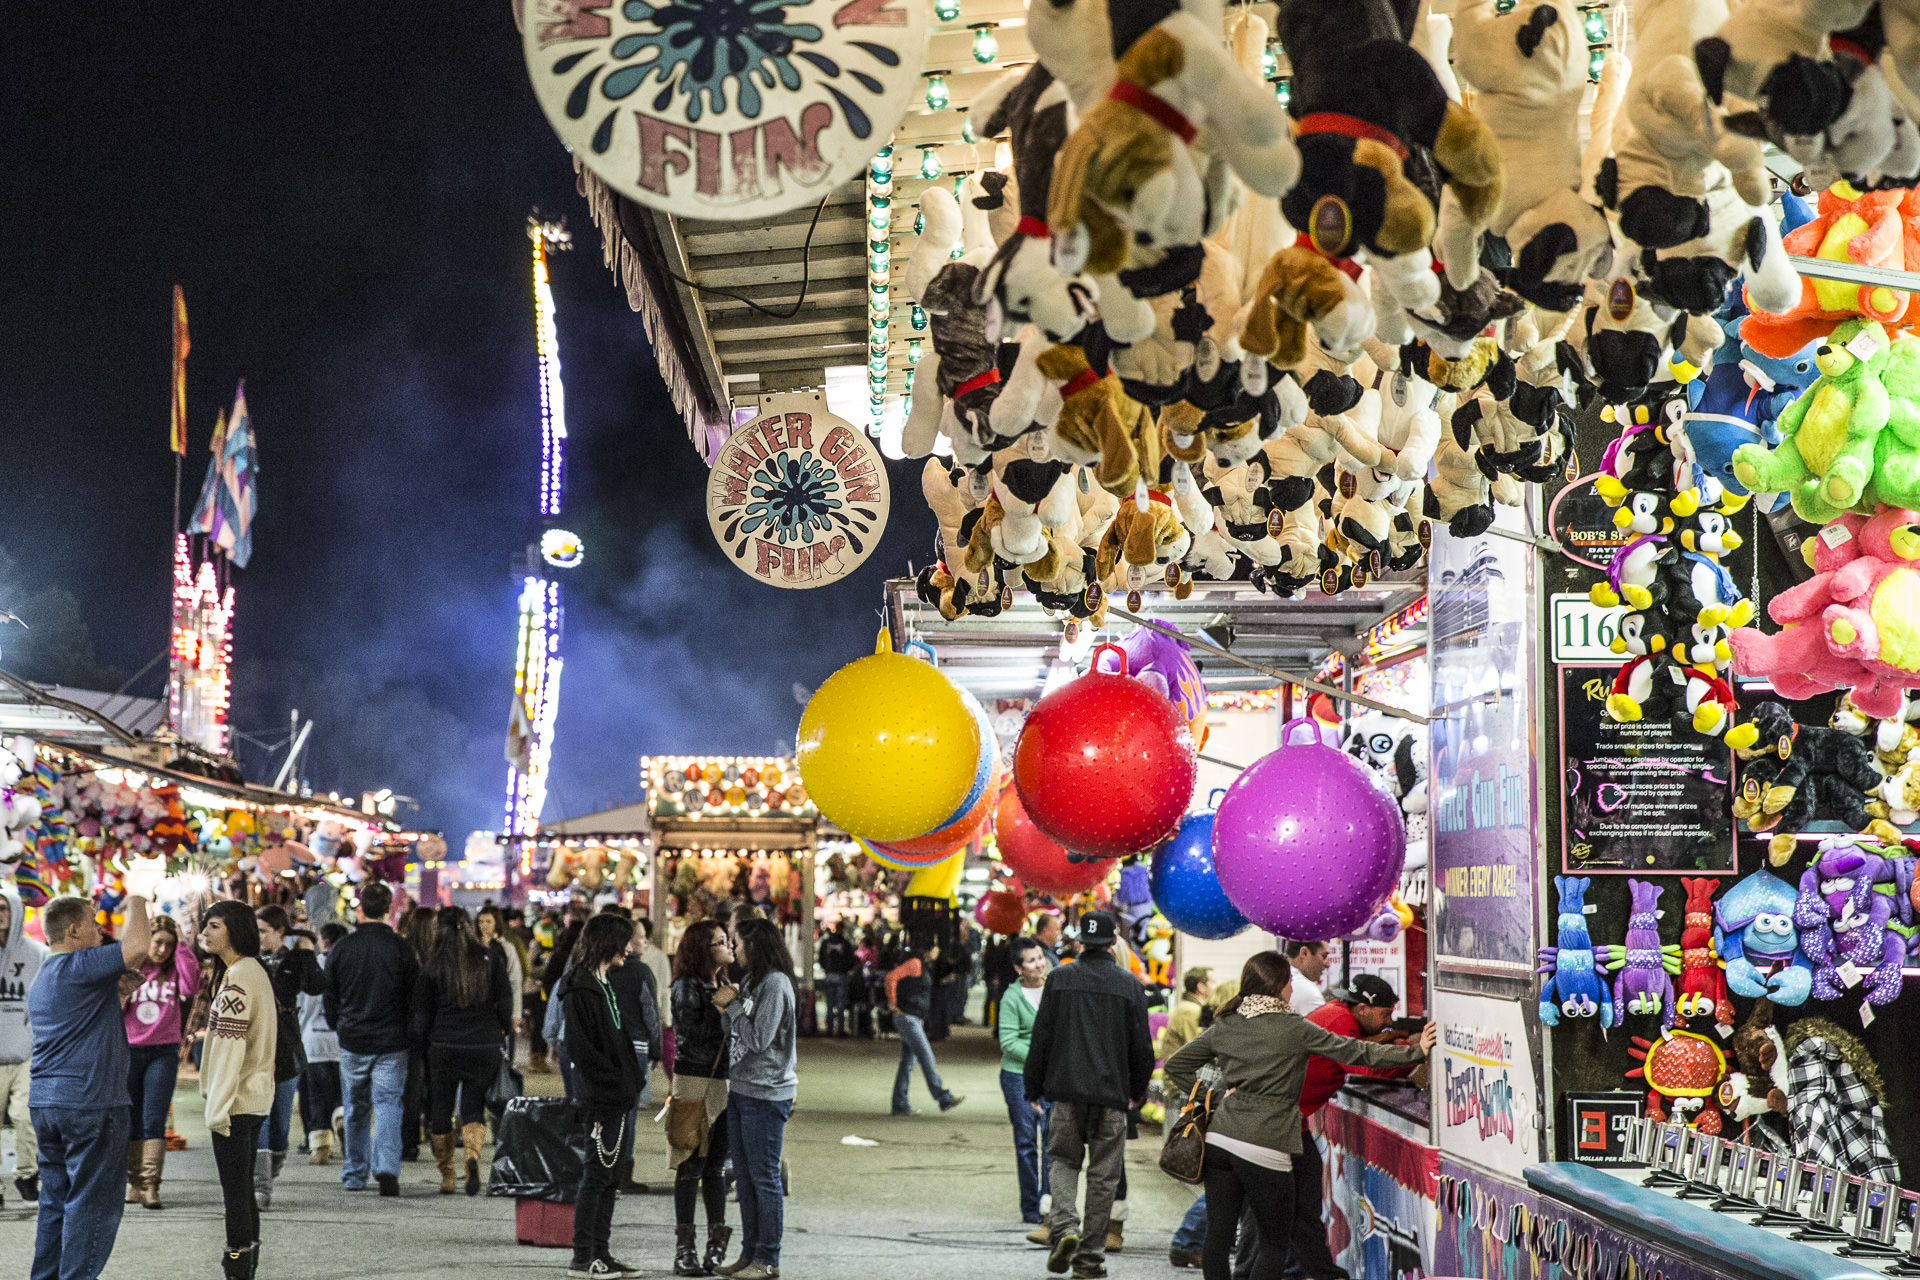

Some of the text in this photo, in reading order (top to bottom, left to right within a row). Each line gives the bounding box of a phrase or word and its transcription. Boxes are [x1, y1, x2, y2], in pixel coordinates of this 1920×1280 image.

[634, 101, 833, 206] FUN
[712, 412, 881, 511] WATER GUN
[1570, 531, 1606, 541] BOB'S
[755, 535, 846, 583] FUN
[1561, 612, 1625, 647] 116
[1621, 723, 1635, 731] prize
[1637, 743, 1655, 751] prizes
[1665, 743, 1682, 751] larger
[1661, 756, 1669, 764] by
[664, 763, 782, 793] RISING
[682, 784, 808, 813] WATERS
[1472, 768, 1497, 833] Gun
[1499, 762, 1524, 831] Fun
[1445, 866, 1469, 898] WINNER
[1470, 865, 1491, 898] EVERY
[1087, 919, 1098, 934] B
[1370, 947, 1388, 955] MUST
